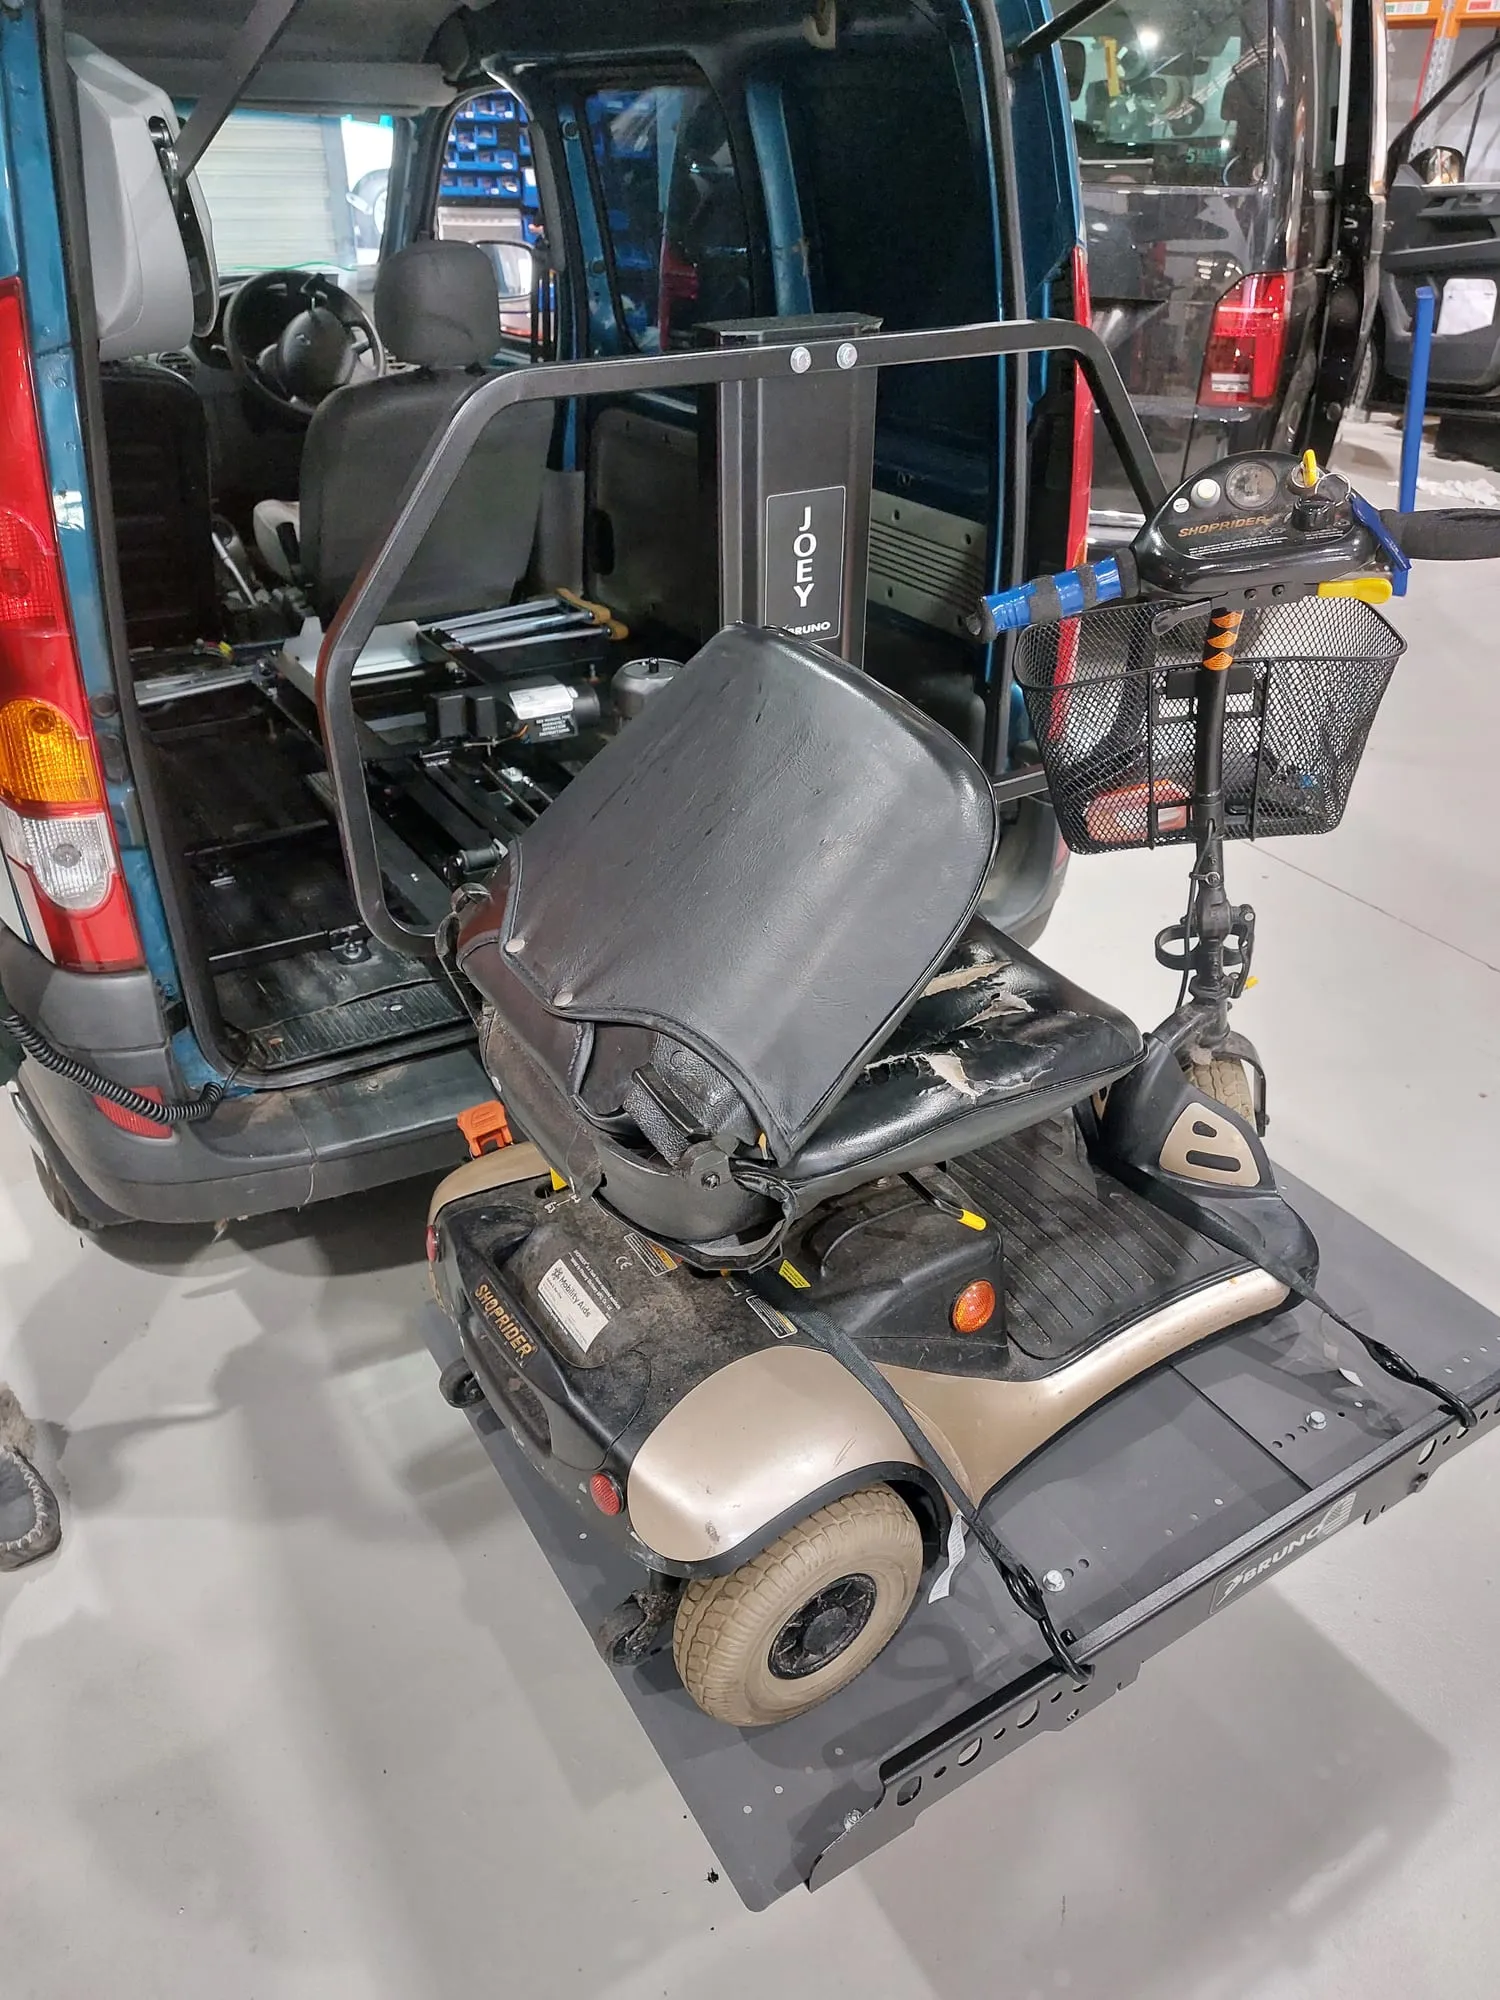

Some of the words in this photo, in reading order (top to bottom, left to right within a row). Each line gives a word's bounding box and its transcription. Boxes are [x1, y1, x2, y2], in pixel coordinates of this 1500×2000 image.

[1178, 516, 1267, 537] SHOPRIDER
[793, 506, 817, 608] JOEY
[474, 1284, 532, 1359] SHOPRIDER
[559, 1275, 580, 1305] Mobility
[577, 1300, 592, 1318] Aids
[1242, 1524, 1323, 1584] BRUNO
